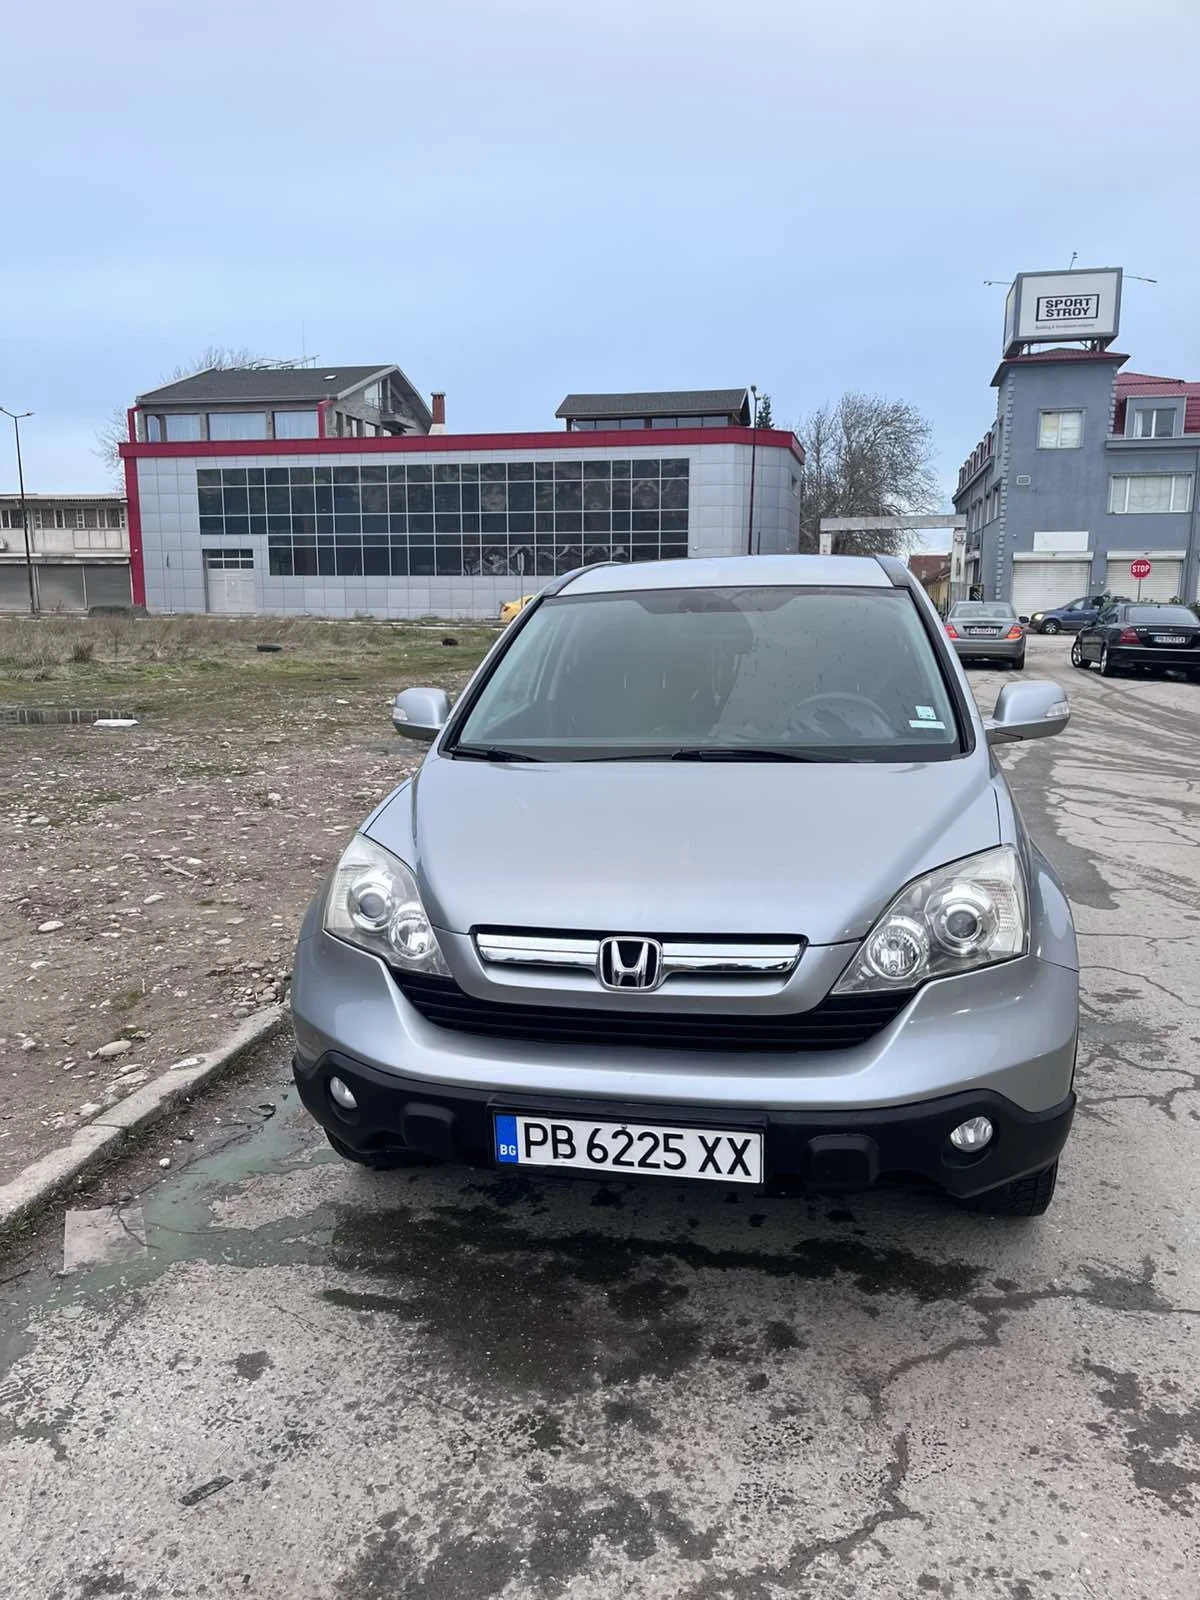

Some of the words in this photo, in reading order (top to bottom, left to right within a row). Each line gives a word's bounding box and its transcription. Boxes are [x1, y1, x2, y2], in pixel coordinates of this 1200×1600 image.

[1045, 298, 1092, 308] SPORT
[1045, 307, 1091, 317] STROY
[1132, 565, 1150, 573] STOP
[499, 1144, 517, 1156] BG
[523, 1122, 577, 1159] PB
[586, 1128, 687, 1170] 6225
[698, 1135, 752, 1176] XX
